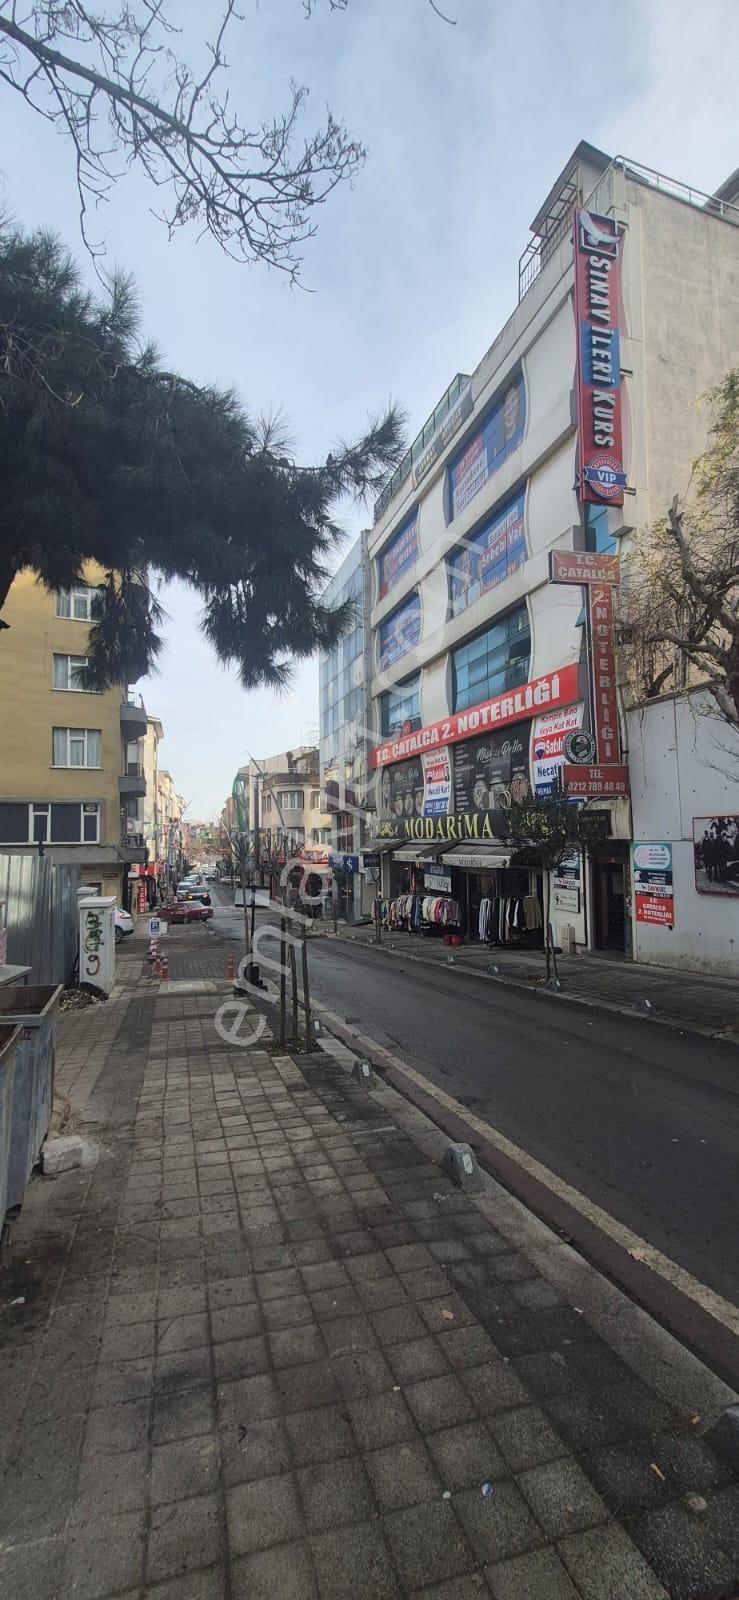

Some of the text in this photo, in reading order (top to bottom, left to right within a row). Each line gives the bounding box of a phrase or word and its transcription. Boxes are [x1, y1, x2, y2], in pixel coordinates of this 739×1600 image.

[589, 254, 612, 325] SINAV
[591, 325, 615, 384] İLERİ
[593, 390, 615, 448] KURS
[597, 471, 617, 483] VIP
[575, 554, 598, 566] T.C.
[376, 674, 560, 764] T.C. ÇATALCA 2. NOTERLİĞİ
[568, 782, 625, 791] 0212 789 48 48
[590, 769, 604, 779] TEL:
